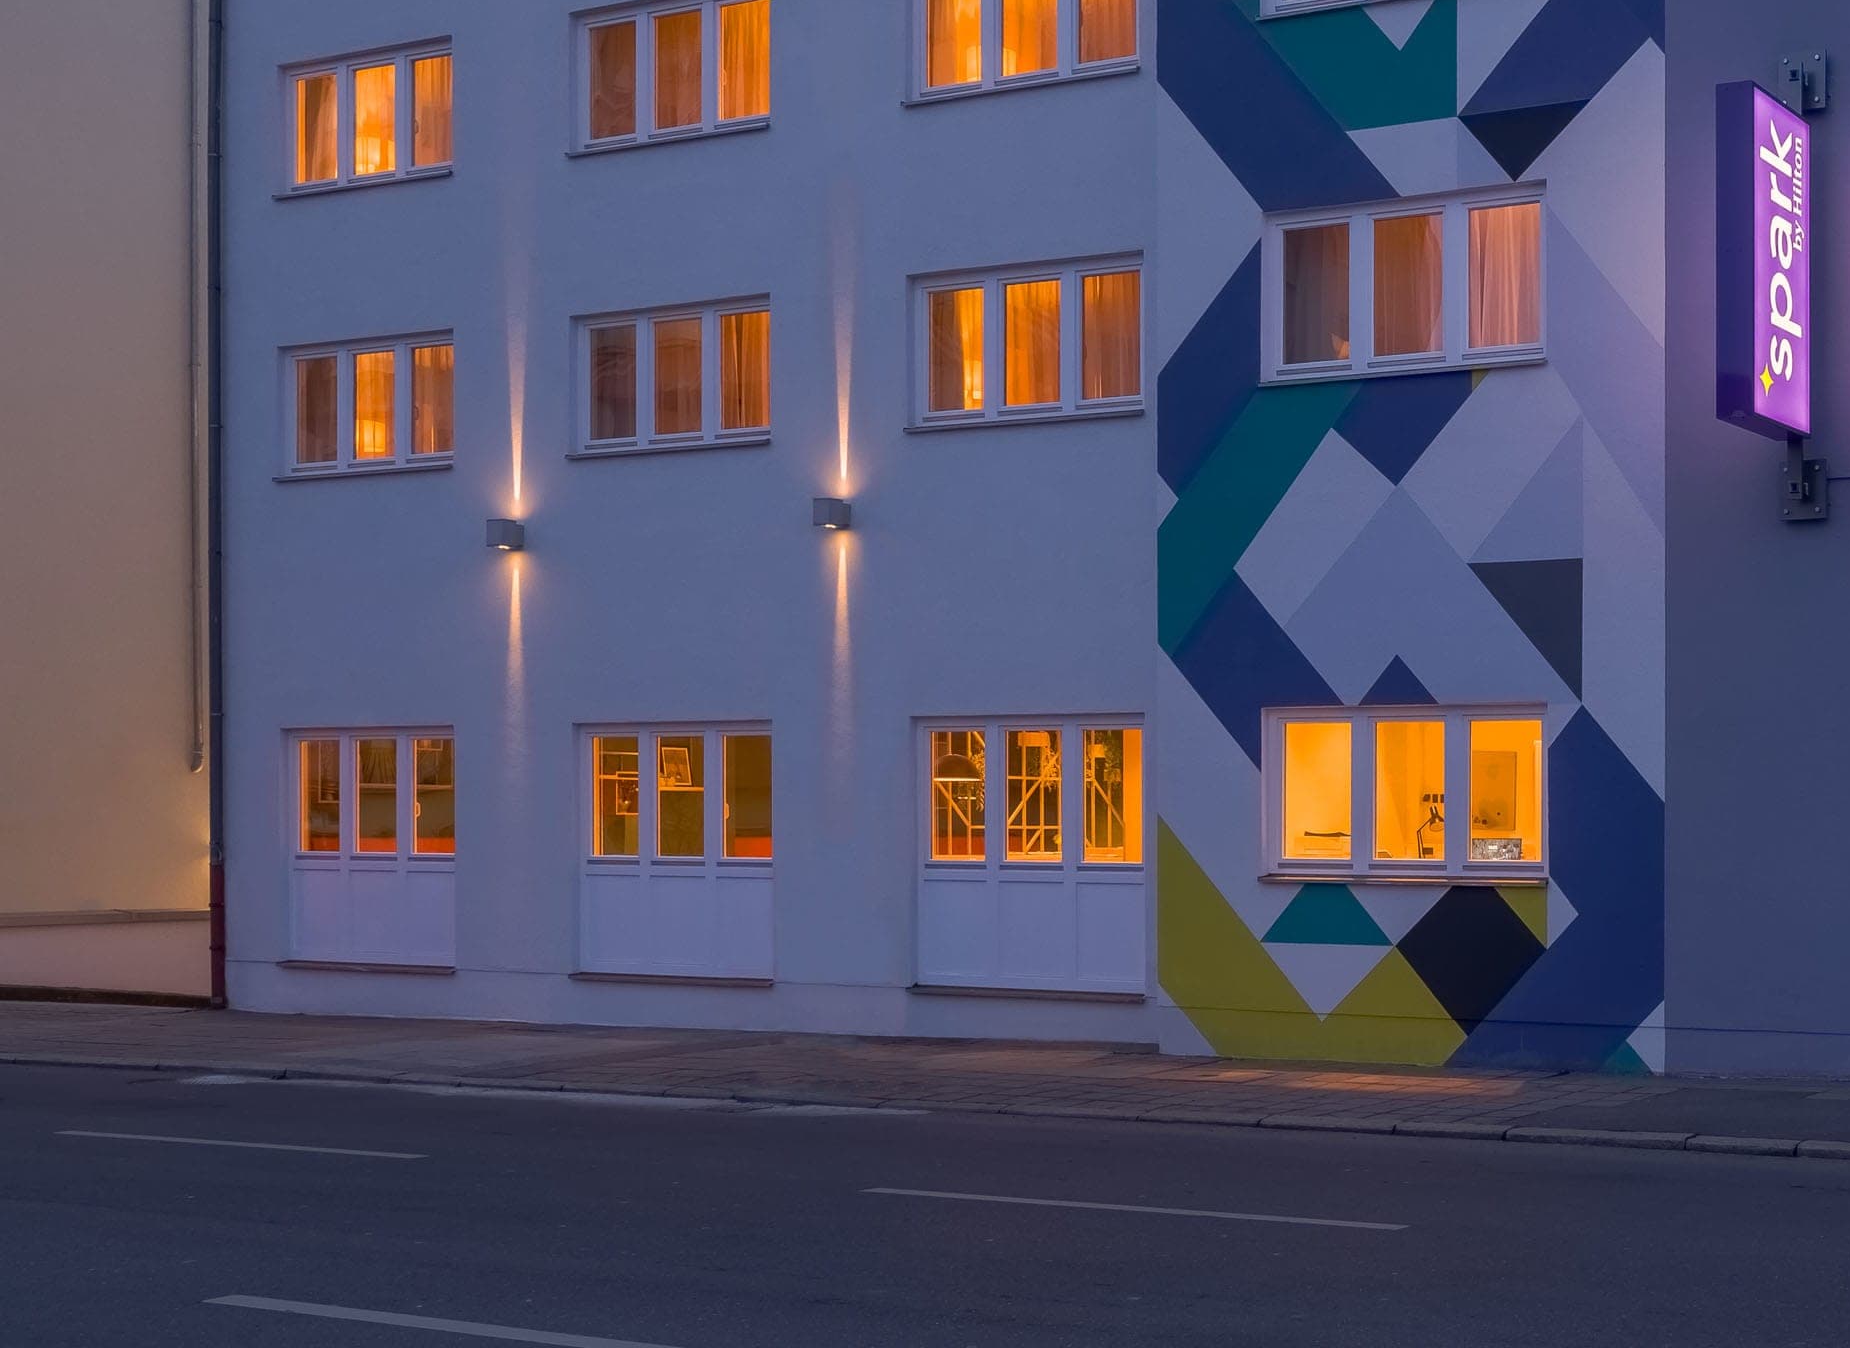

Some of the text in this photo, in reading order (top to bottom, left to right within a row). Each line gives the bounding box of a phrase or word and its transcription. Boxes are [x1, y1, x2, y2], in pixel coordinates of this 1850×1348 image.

[1760, 118, 1802, 382] spark
[1792, 137, 1805, 252] by Hilton
